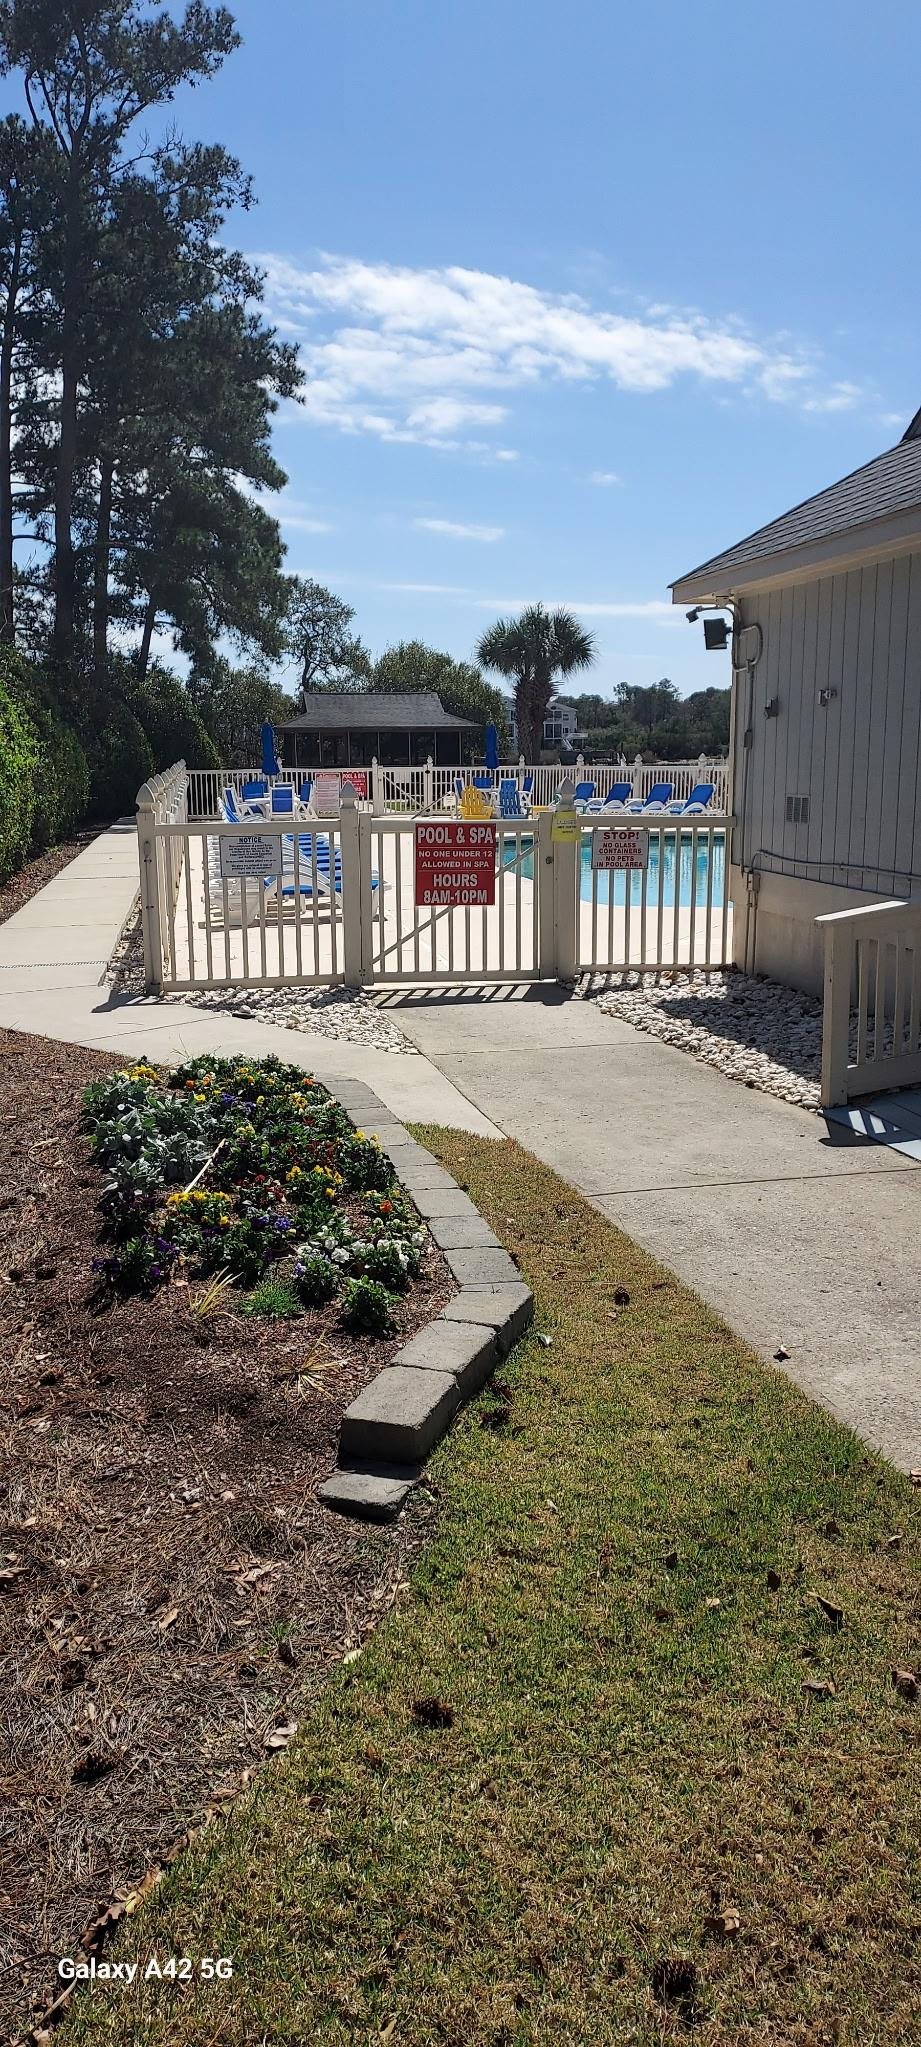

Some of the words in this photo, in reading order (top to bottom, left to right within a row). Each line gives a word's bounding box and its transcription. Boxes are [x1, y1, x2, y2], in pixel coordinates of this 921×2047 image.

[417, 827, 452, 844] POOL
[456, 827, 465, 844] &
[470, 827, 494, 844] SPA
[603, 832, 640, 840] STOP!
[433, 874, 478, 887] HOURS
[423, 890, 488, 904] 8AM-10PM
